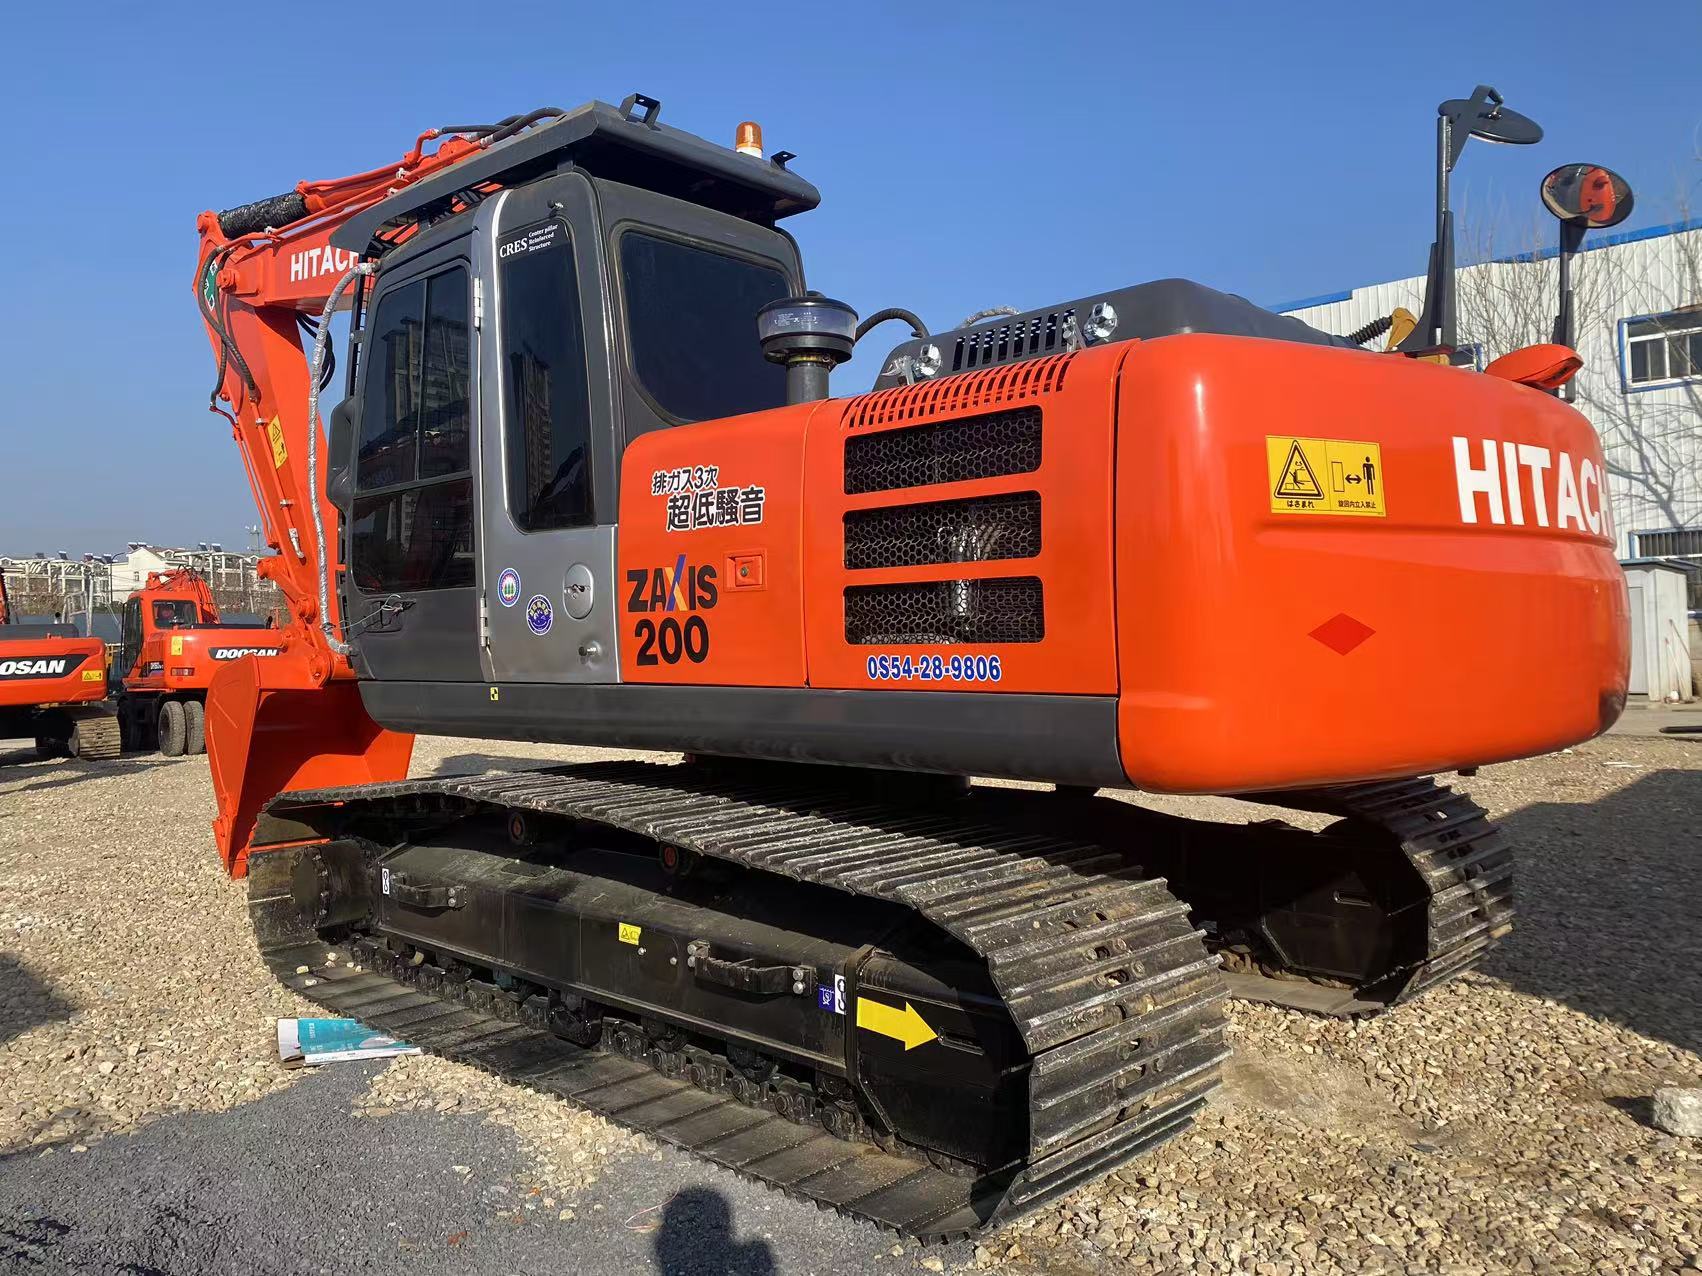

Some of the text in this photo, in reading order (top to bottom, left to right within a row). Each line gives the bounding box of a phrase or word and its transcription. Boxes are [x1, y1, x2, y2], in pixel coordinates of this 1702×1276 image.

[500, 237, 528, 258] CRES
[529, 241, 551, 252] Structure
[651, 465, 719, 496] 排ガス3次
[627, 554, 718, 613] ZAXIS
[635, 615, 709, 666] 200
